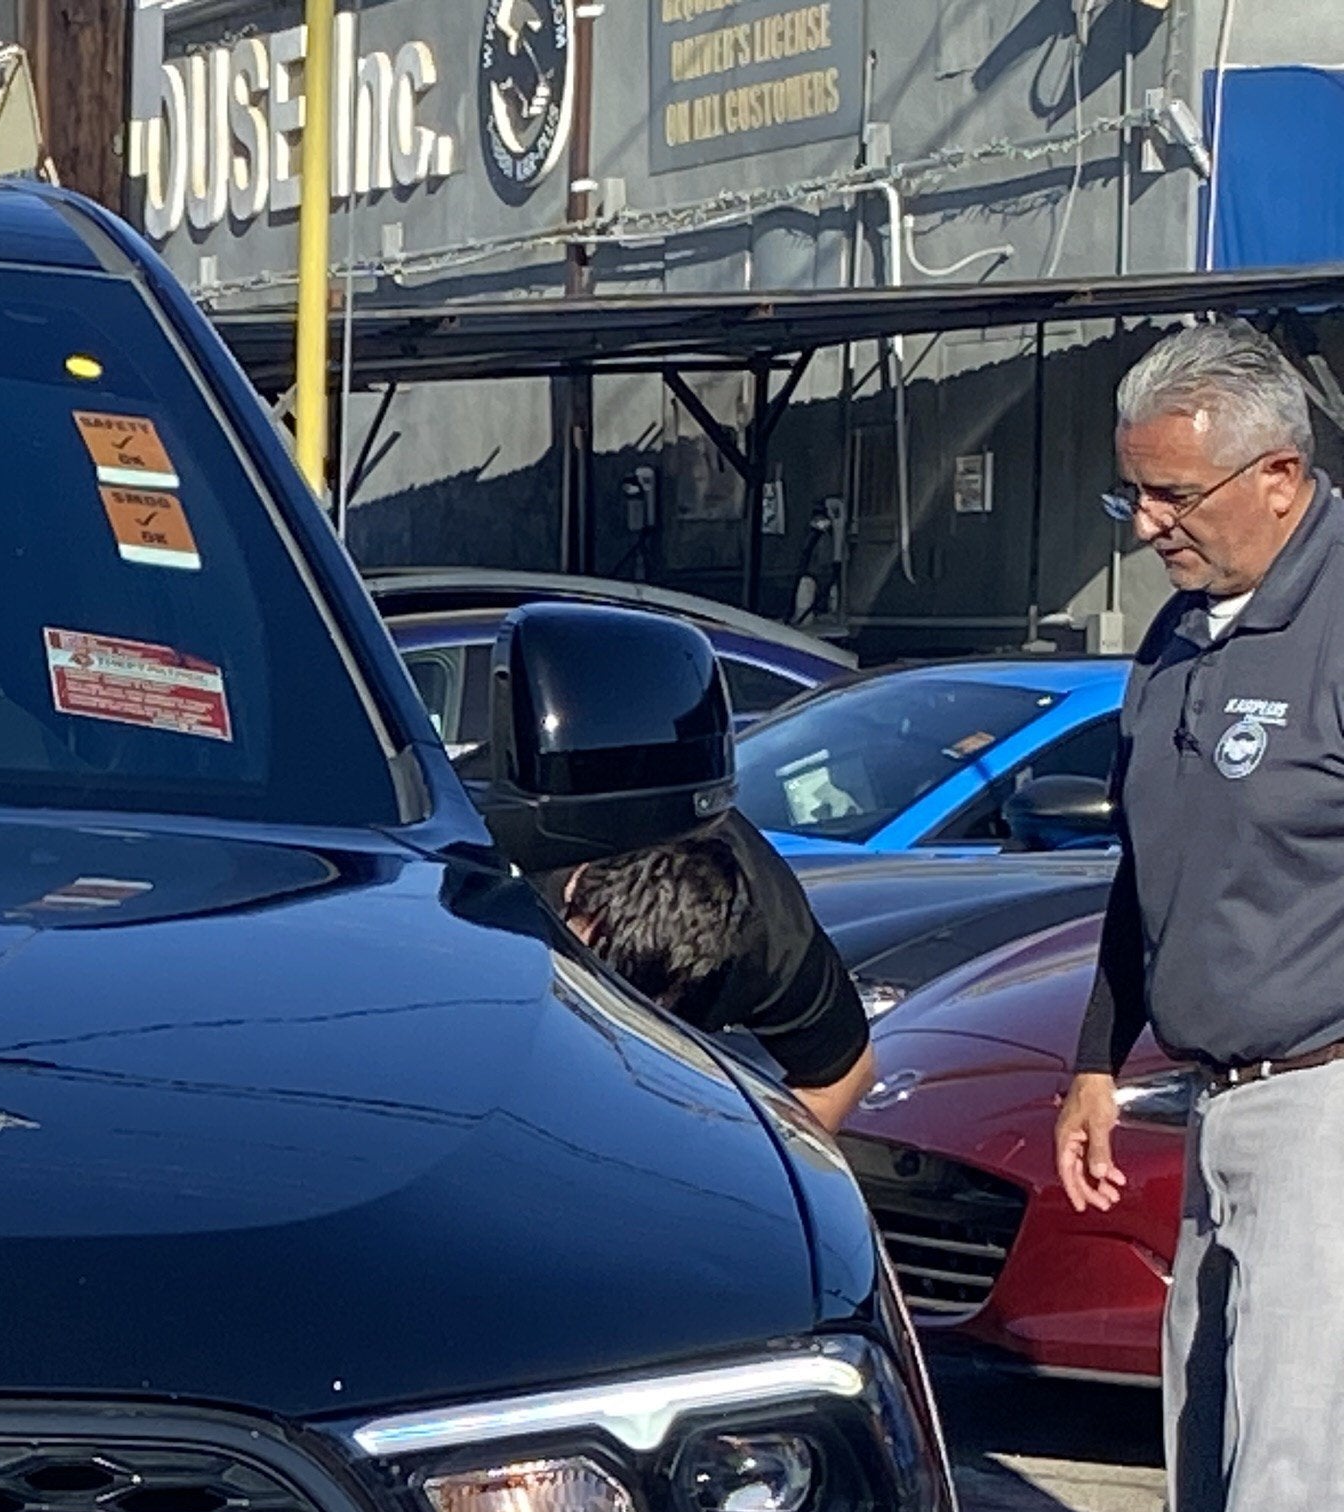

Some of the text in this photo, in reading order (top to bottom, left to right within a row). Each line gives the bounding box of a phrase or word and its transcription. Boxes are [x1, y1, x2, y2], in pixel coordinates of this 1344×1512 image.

[753, 3, 832, 63] LICENSE
[331, 12, 454, 198] Inc.
[693, 94, 724, 141] ALL
[724, 67, 840, 133] CUSTOMERS
[79, 415, 150, 435] SAFETY
[118, 453, 145, 467] OK
[112, 491, 171, 510] SMOG
[141, 531, 168, 545] OK
